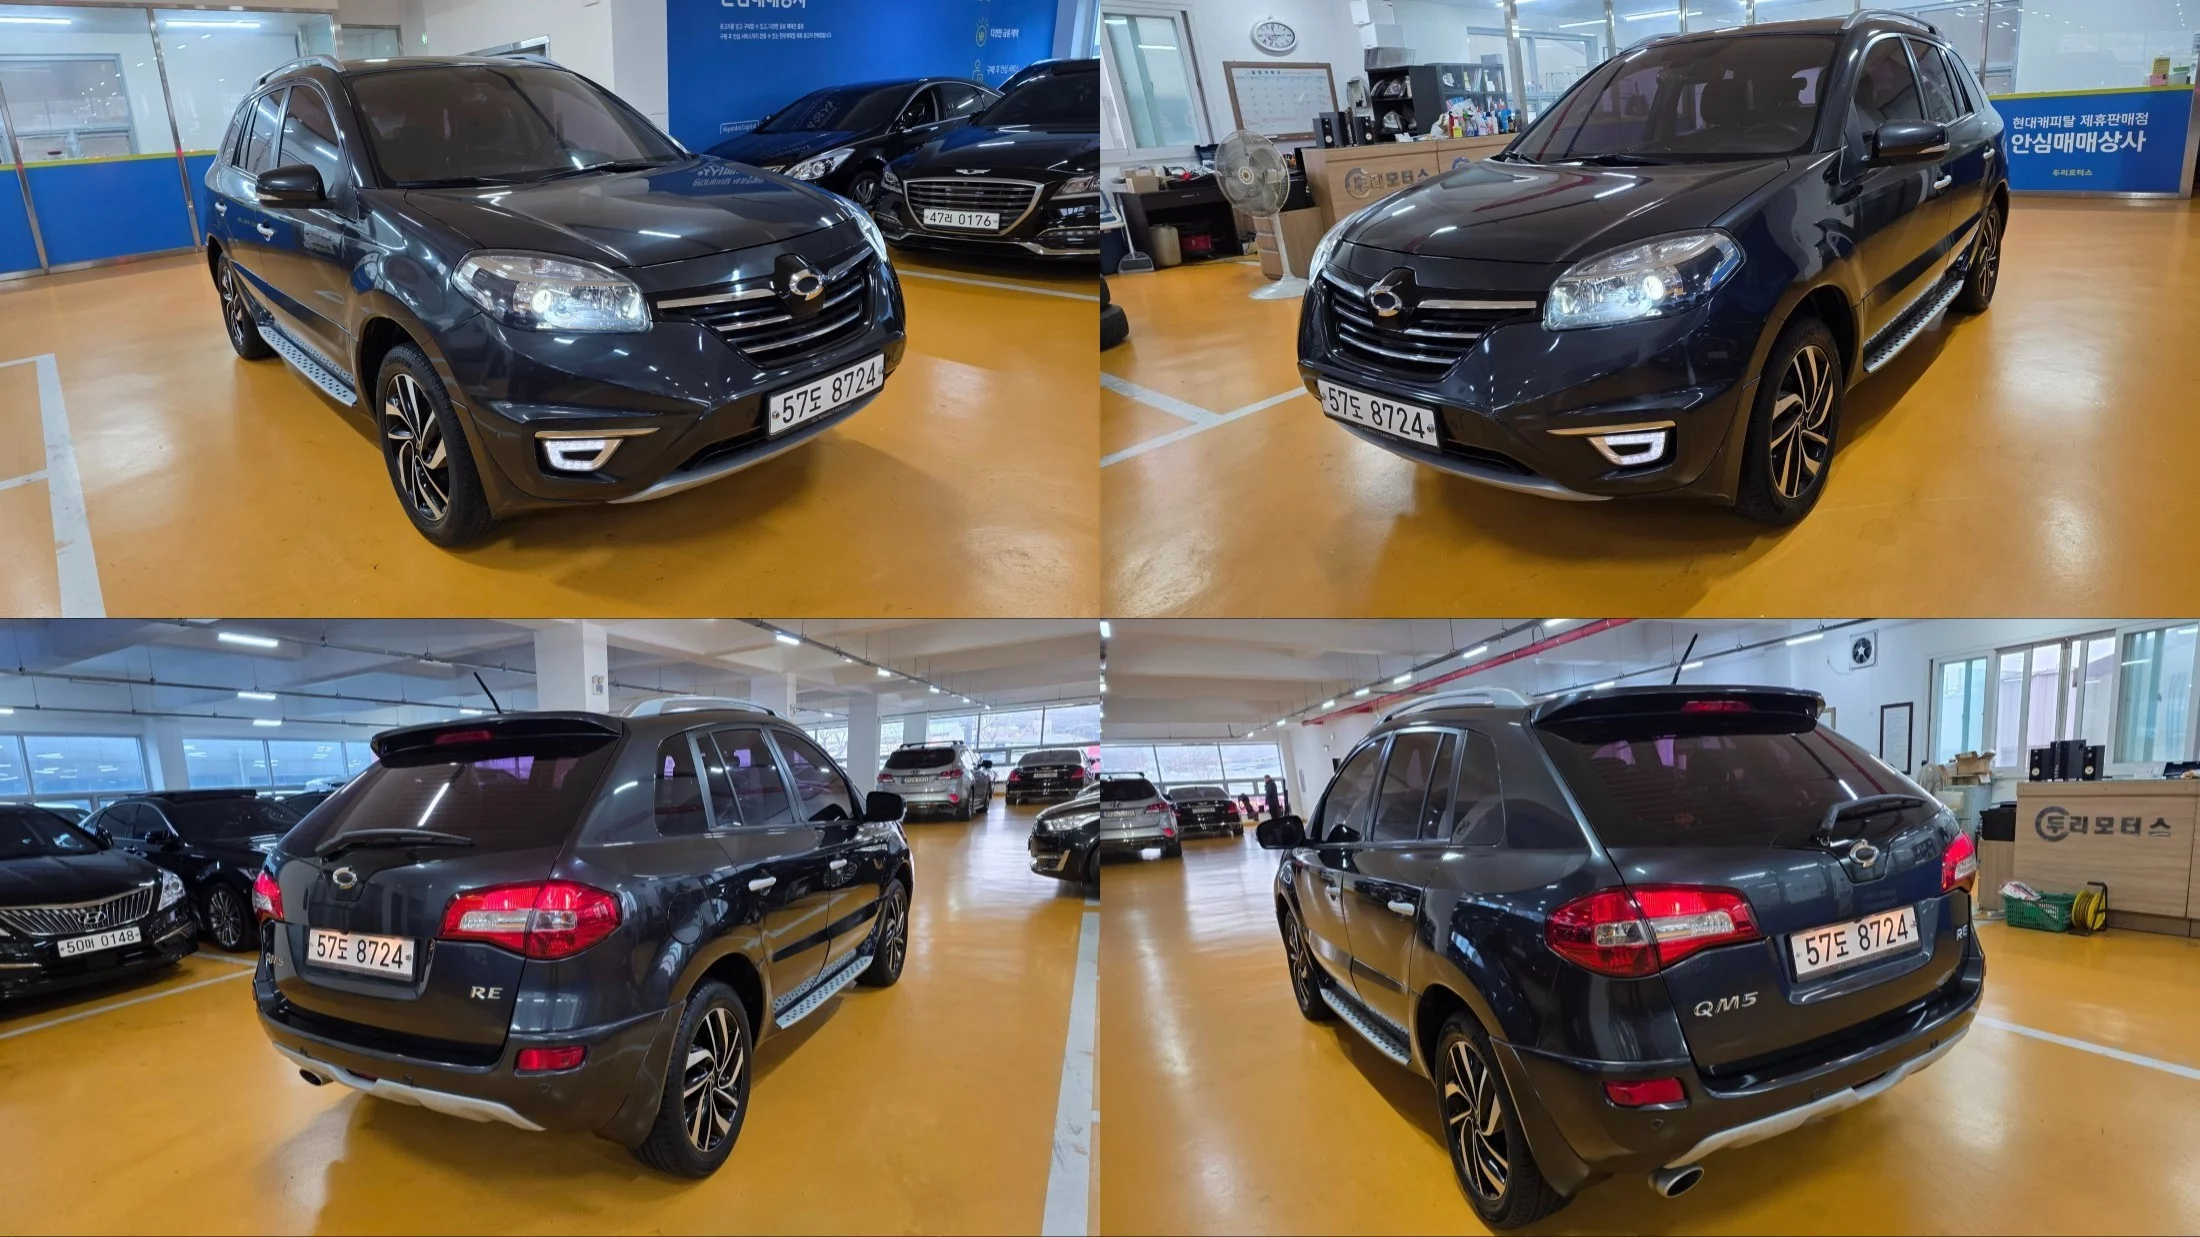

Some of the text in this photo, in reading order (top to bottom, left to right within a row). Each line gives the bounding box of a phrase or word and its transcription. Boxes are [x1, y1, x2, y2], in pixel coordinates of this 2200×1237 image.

[2012, 112, 2149, 130] 현대캐피탈 제휴판매점
[2011, 130, 2147, 154] 안심매매상사
[2052, 168, 2093, 177] 두리모터스
[929, 212, 991, 227] 47러 0176
[782, 362, 876, 423] 57도 8724
[1328, 387, 1363, 420] 57도
[1370, 400, 1425, 439] 8724
[2046, 816, 2171, 837] 두리모터스
[100, 930, 135, 947] 0148
[1805, 931, 1849, 966] 57도
[1859, 913, 1909, 951] 8724
[1956, 924, 1968, 941] RE
[317, 934, 403, 969] 57도 8724
[470, 986, 504, 1000] RE
[1693, 991, 1759, 1018] QM5
